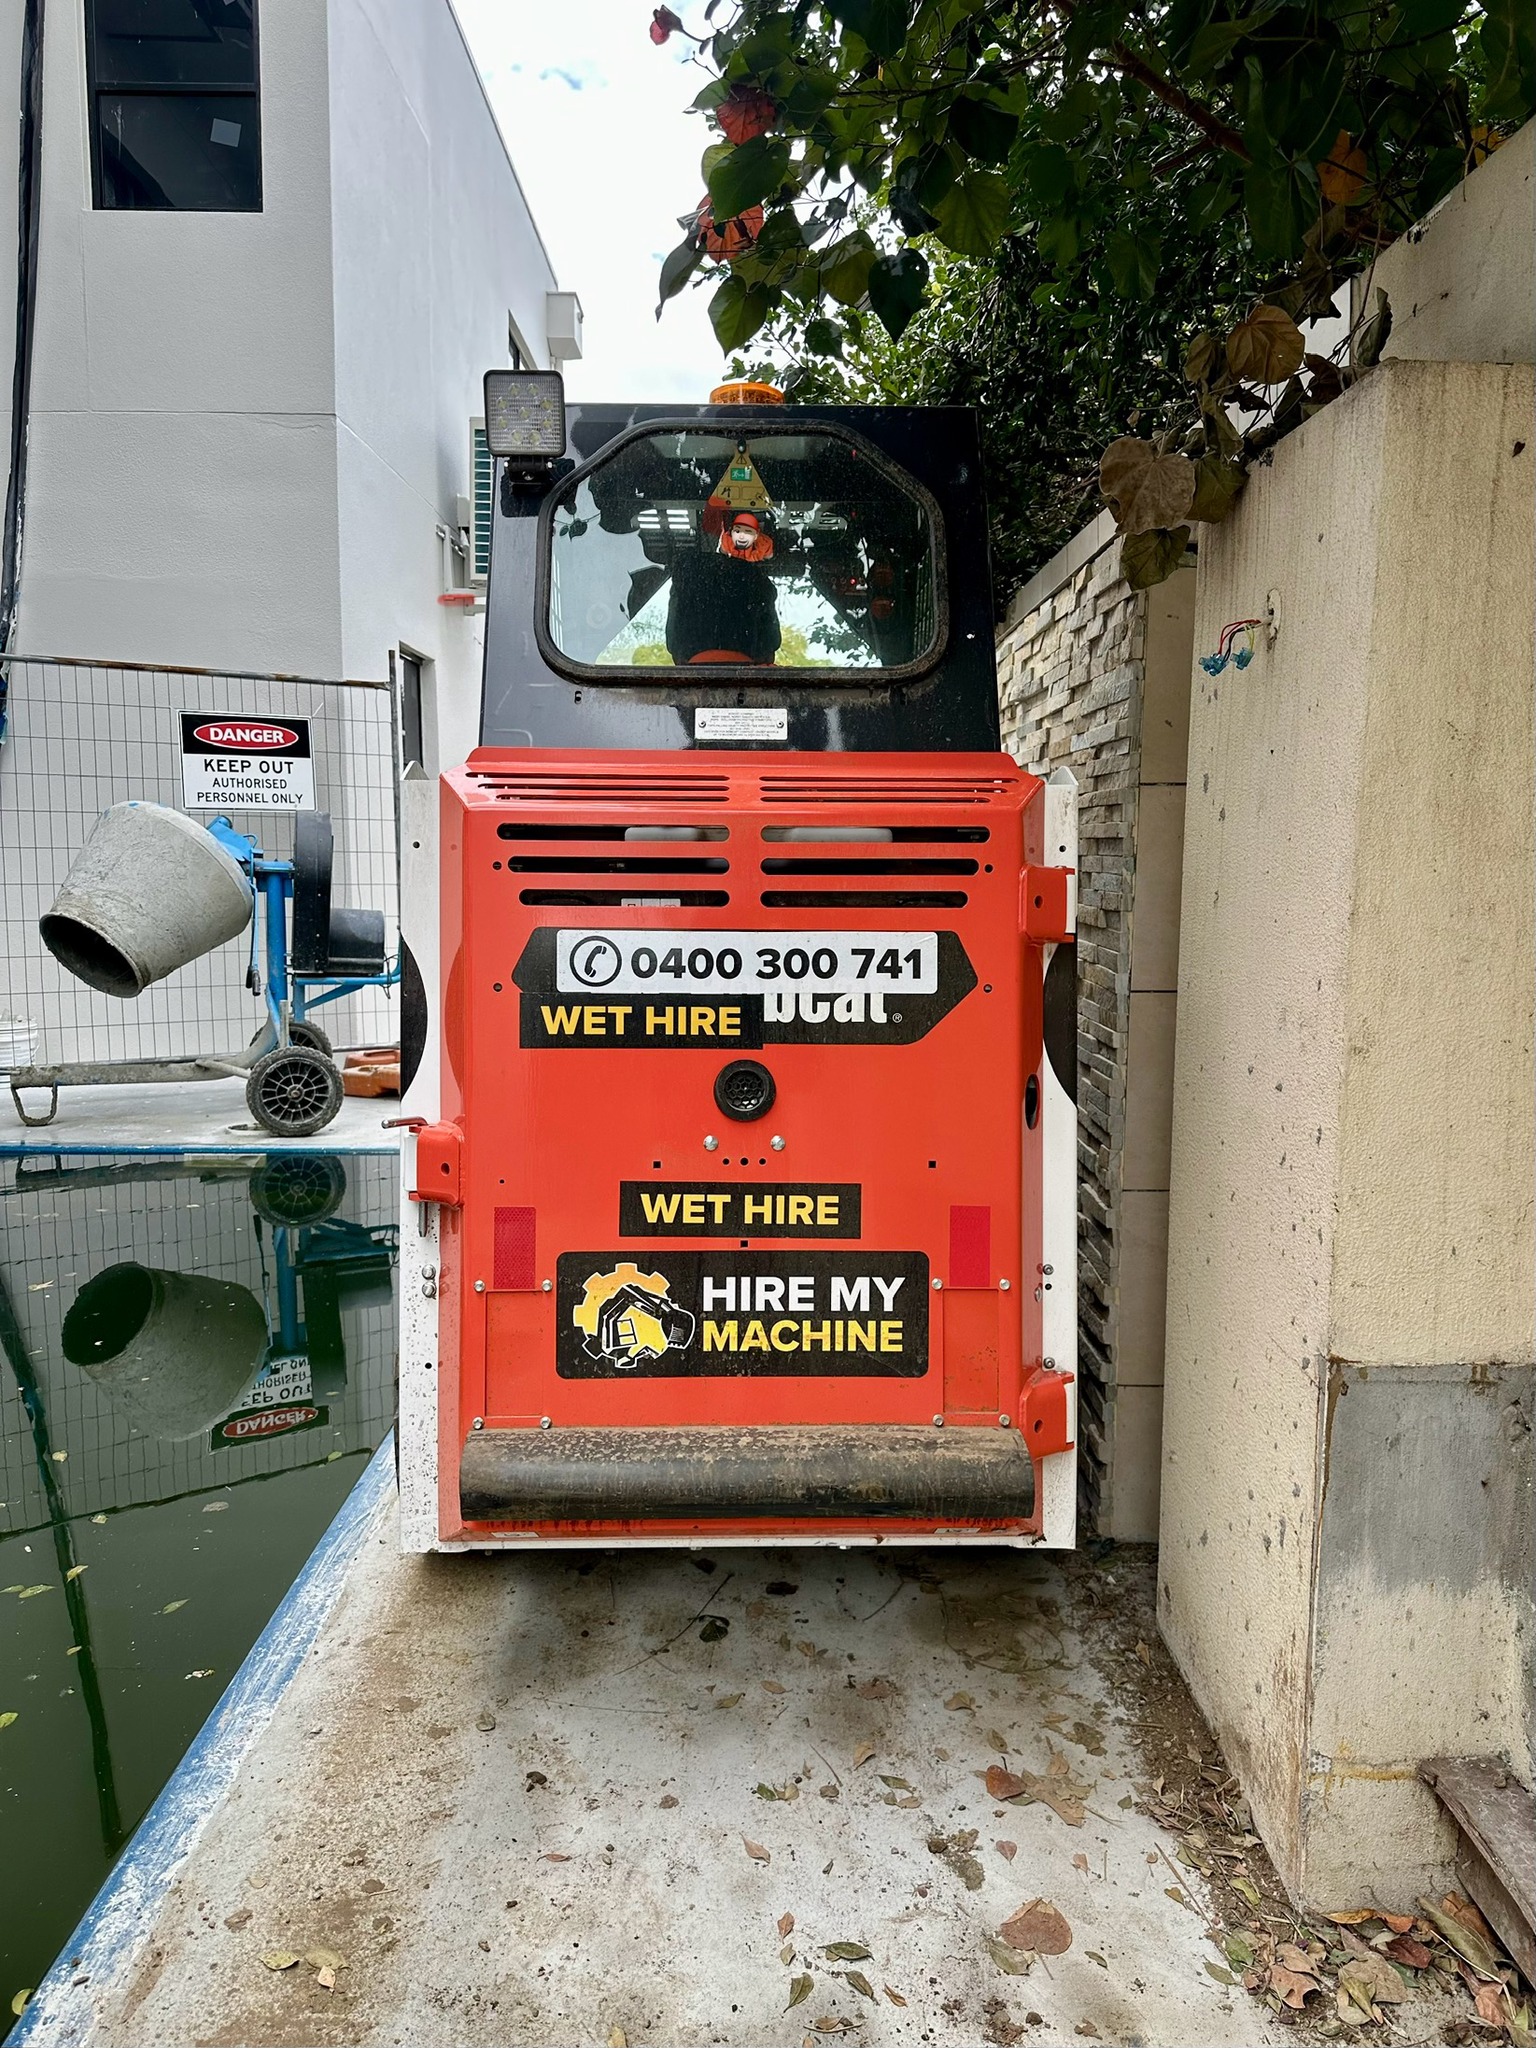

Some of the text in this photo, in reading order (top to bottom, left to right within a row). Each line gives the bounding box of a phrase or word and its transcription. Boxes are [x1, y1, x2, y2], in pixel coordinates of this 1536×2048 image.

[209, 727, 285, 744] DANGER
[204, 759, 294, 774] KEEP OUT
[197, 792, 303, 804] PERSONNEL ONLY
[212, 778, 287, 789] AUTHORISED
[631, 947, 921, 980] 0400 300 741
[540, 1005, 741, 1036] WET HIRE
[640, 1193, 839, 1225] WET HIRE
[702, 1276, 906, 1312] HIRE MY
[702, 1320, 904, 1352] MACHINE
